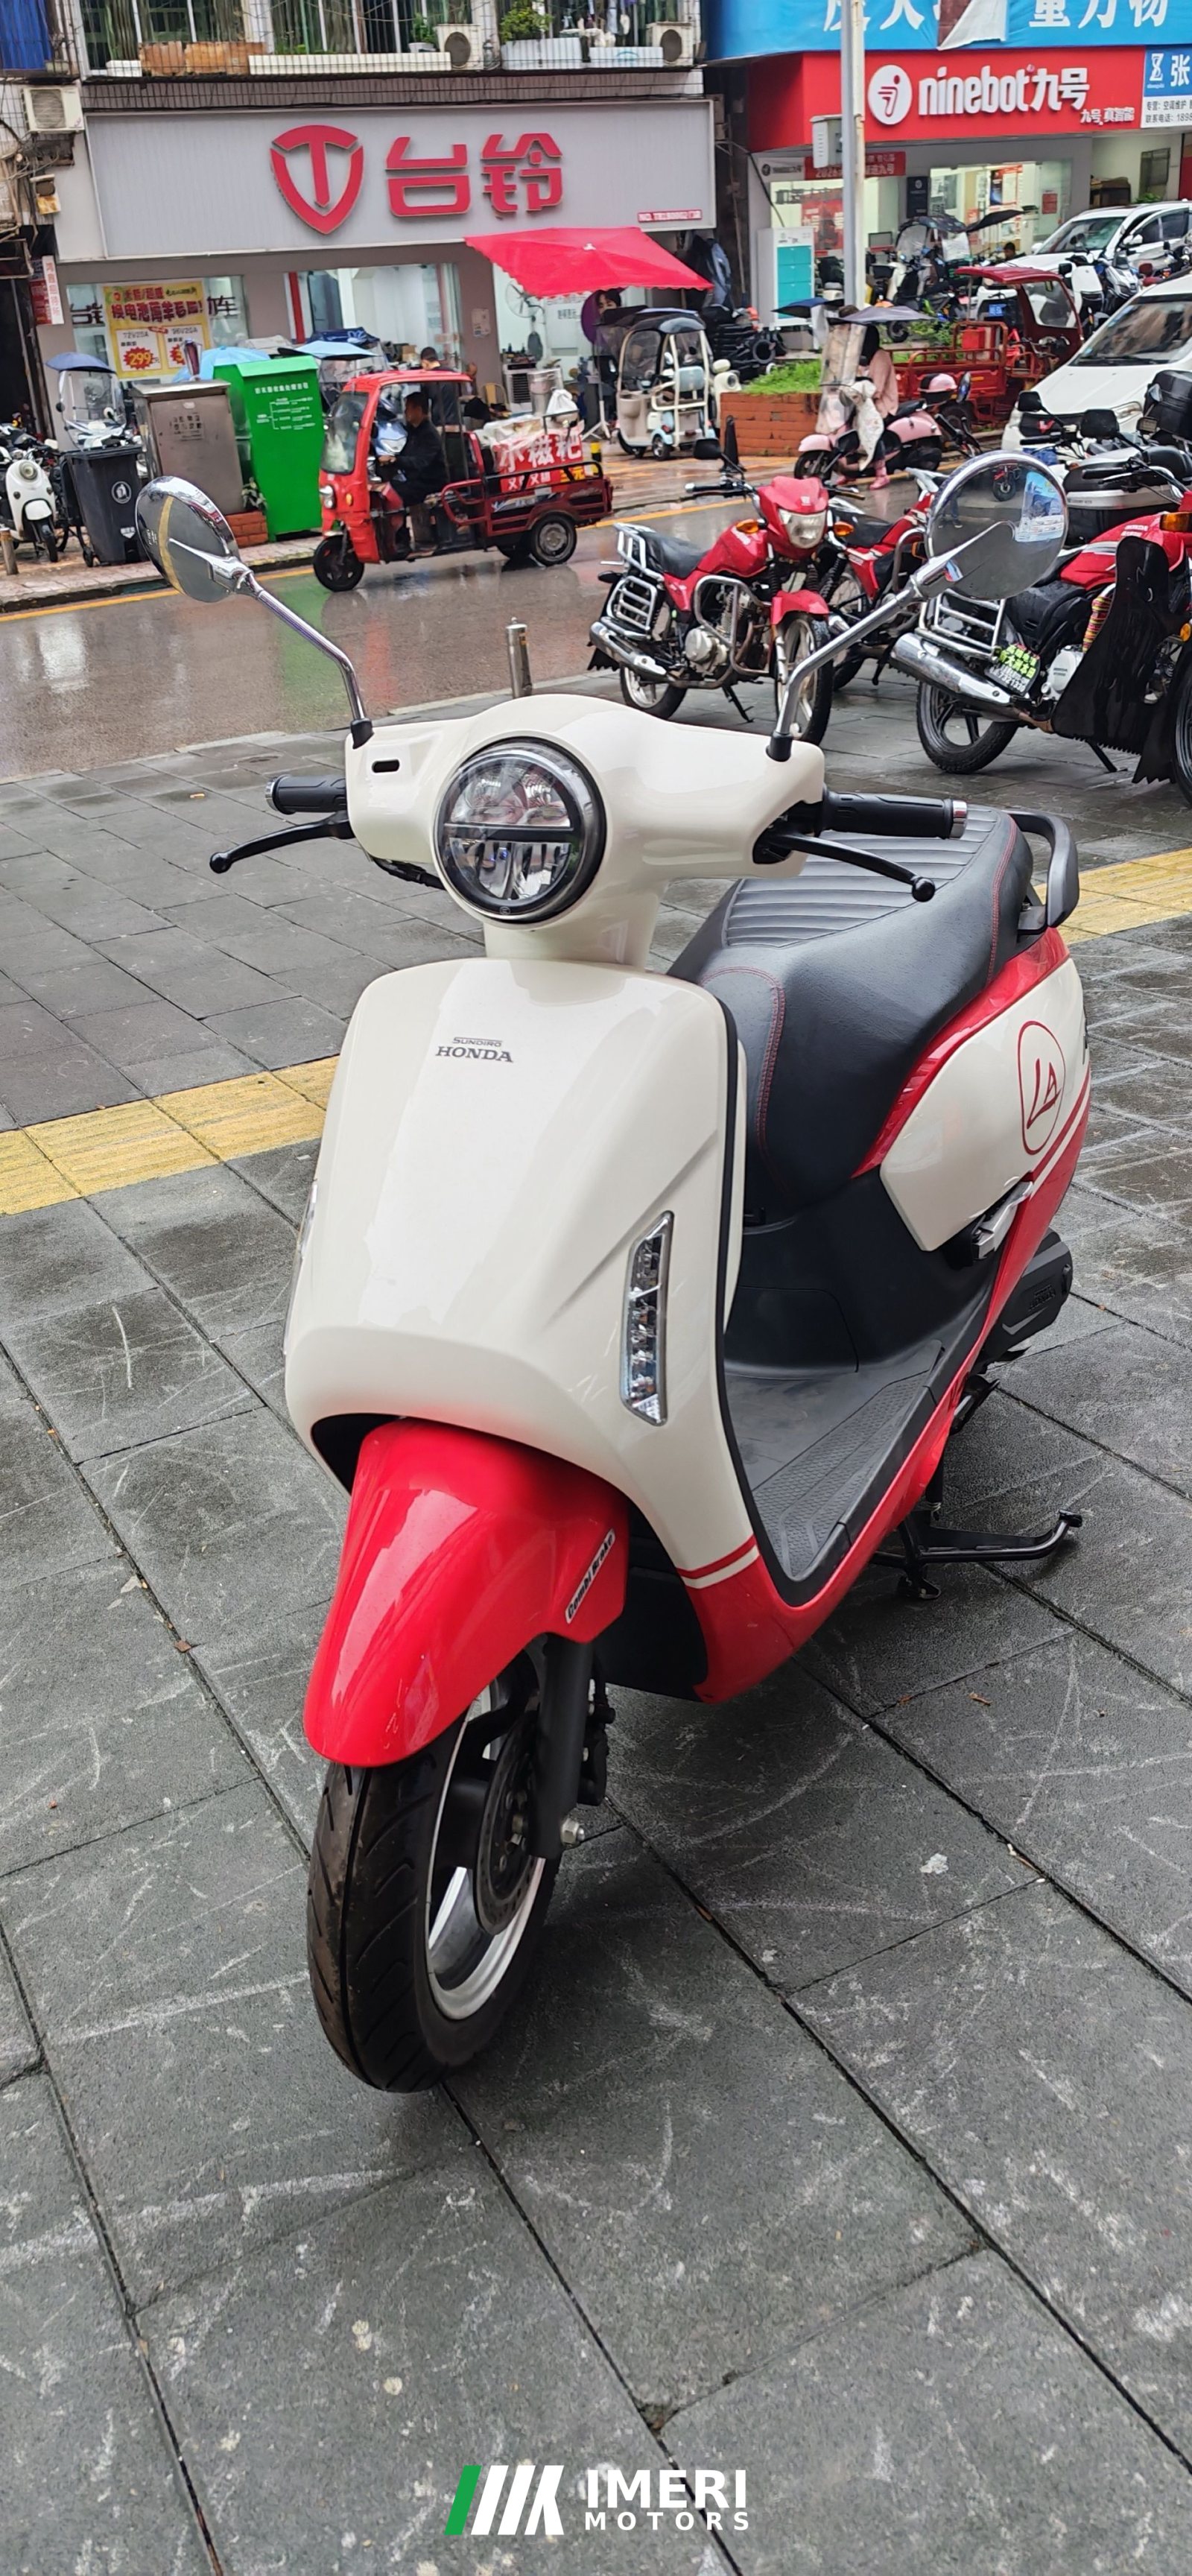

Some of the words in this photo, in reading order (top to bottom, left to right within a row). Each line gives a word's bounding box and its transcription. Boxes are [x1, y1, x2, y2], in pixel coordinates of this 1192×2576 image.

[1170, 54, 1191, 86] 张
[919, 66, 1028, 115] ninebot
[1030, 67, 1090, 111] 九号
[386, 133, 562, 217] 台铃
[435, 1046, 513, 1063] HONDA
[453, 1037, 503, 1047] SUNDIRO
